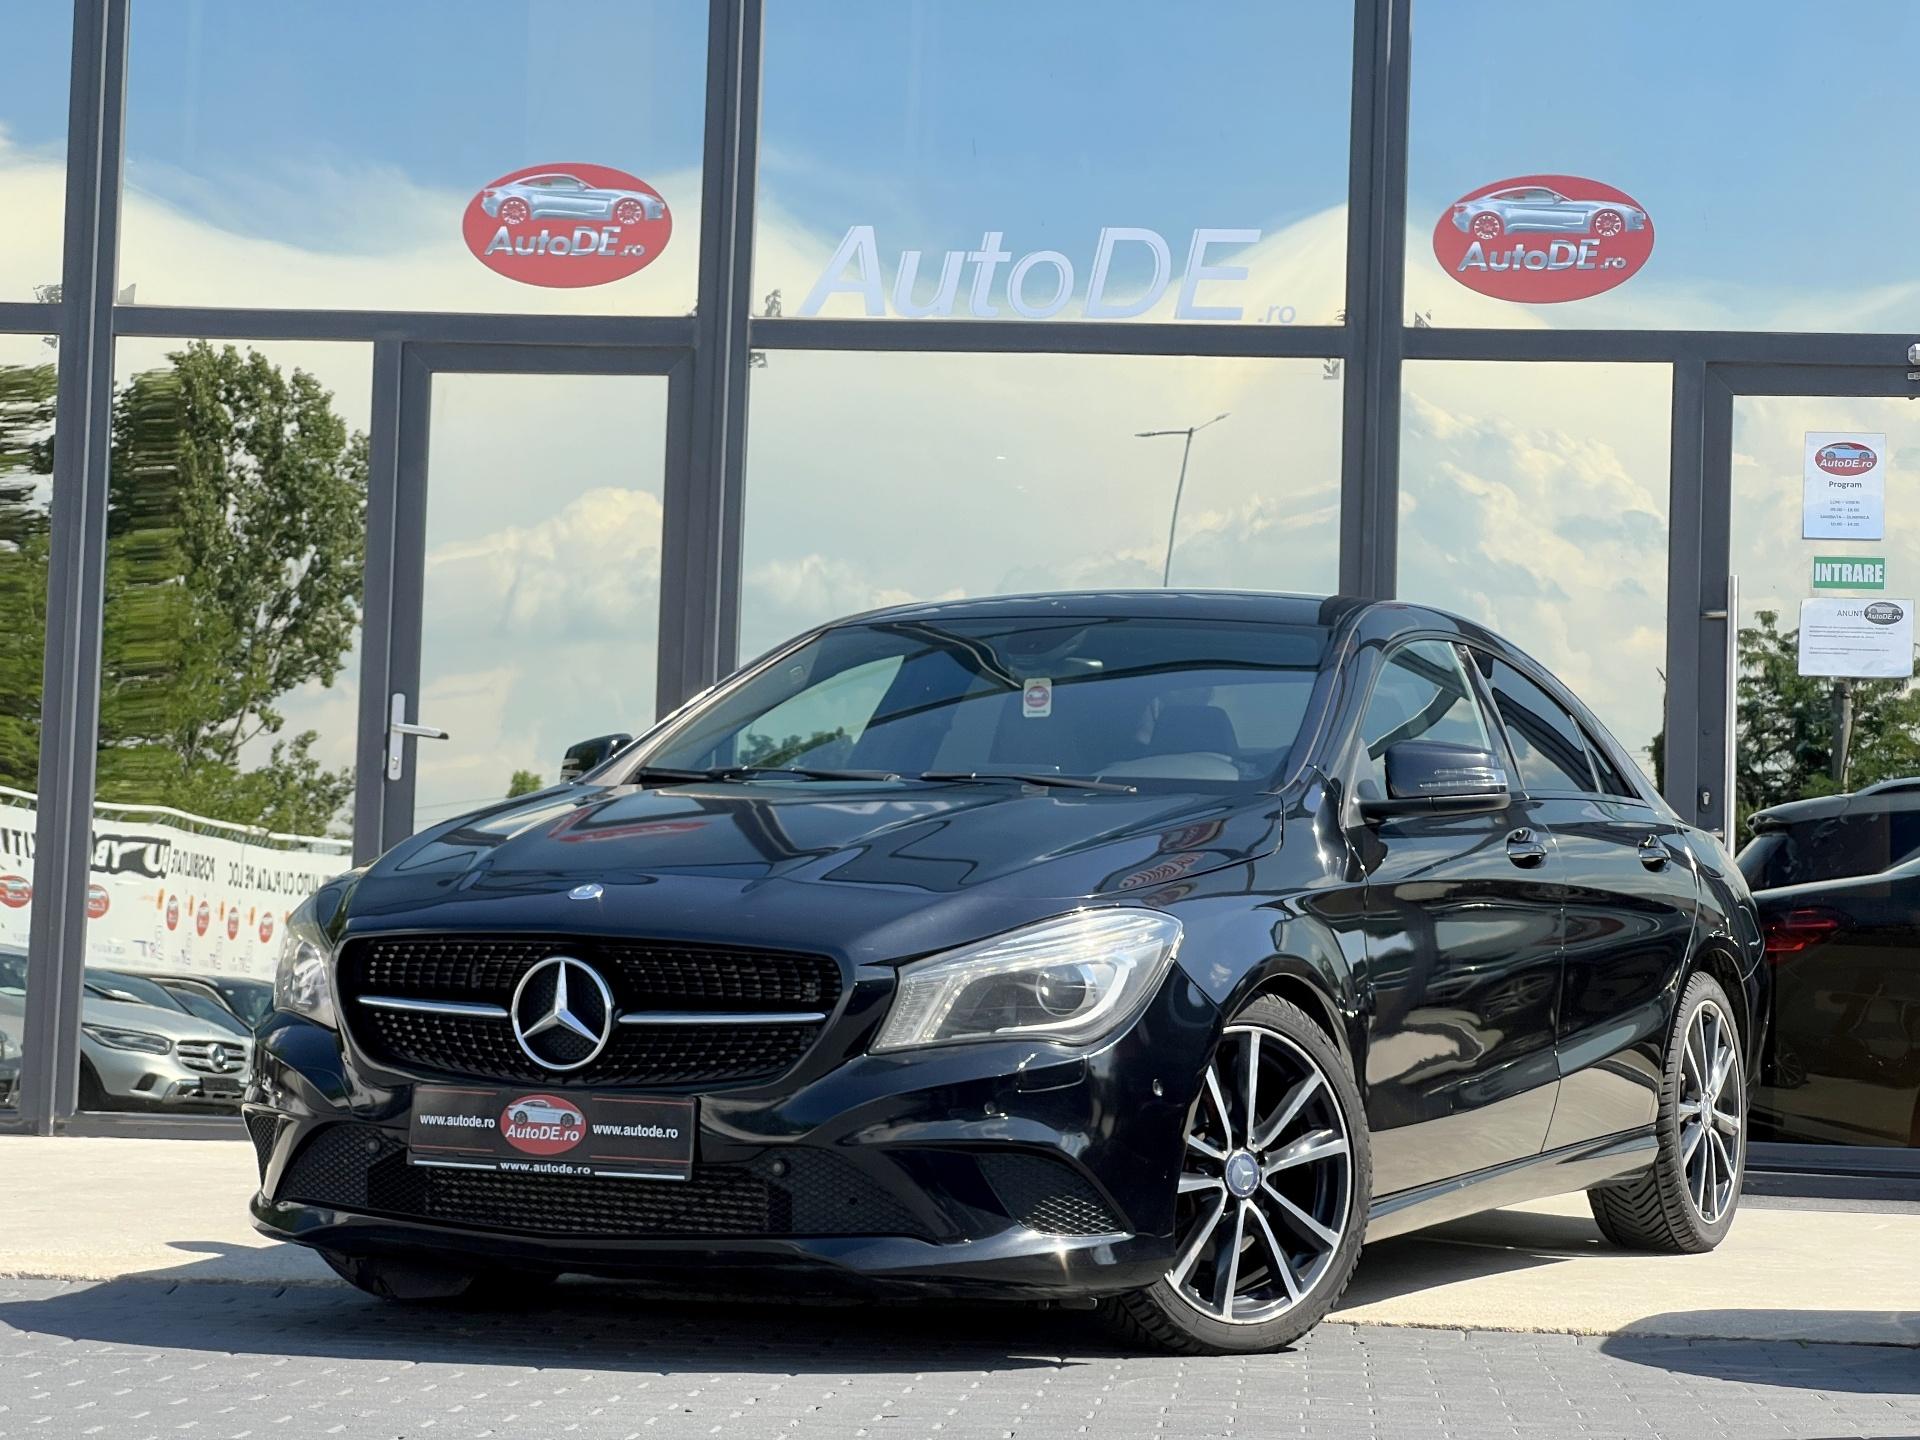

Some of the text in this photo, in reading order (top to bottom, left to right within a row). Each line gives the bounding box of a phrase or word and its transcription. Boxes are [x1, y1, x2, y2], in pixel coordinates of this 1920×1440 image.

[484, 225, 645, 256] AutoDE.ro
[1457, 239, 1627, 272] AutoDE.ro
[1819, 458, 1873, 468] AutoDE.ro
[1828, 481, 1863, 490] Program
[1814, 563, 1884, 583] INTRARE
[419, 1113, 496, 1129] www.autode.ro
[505, 1124, 580, 1142] AutoDE.ro
[592, 1122, 679, 1139] www.autode.ro
[500, 1162, 591, 1175] www.autode.ro
